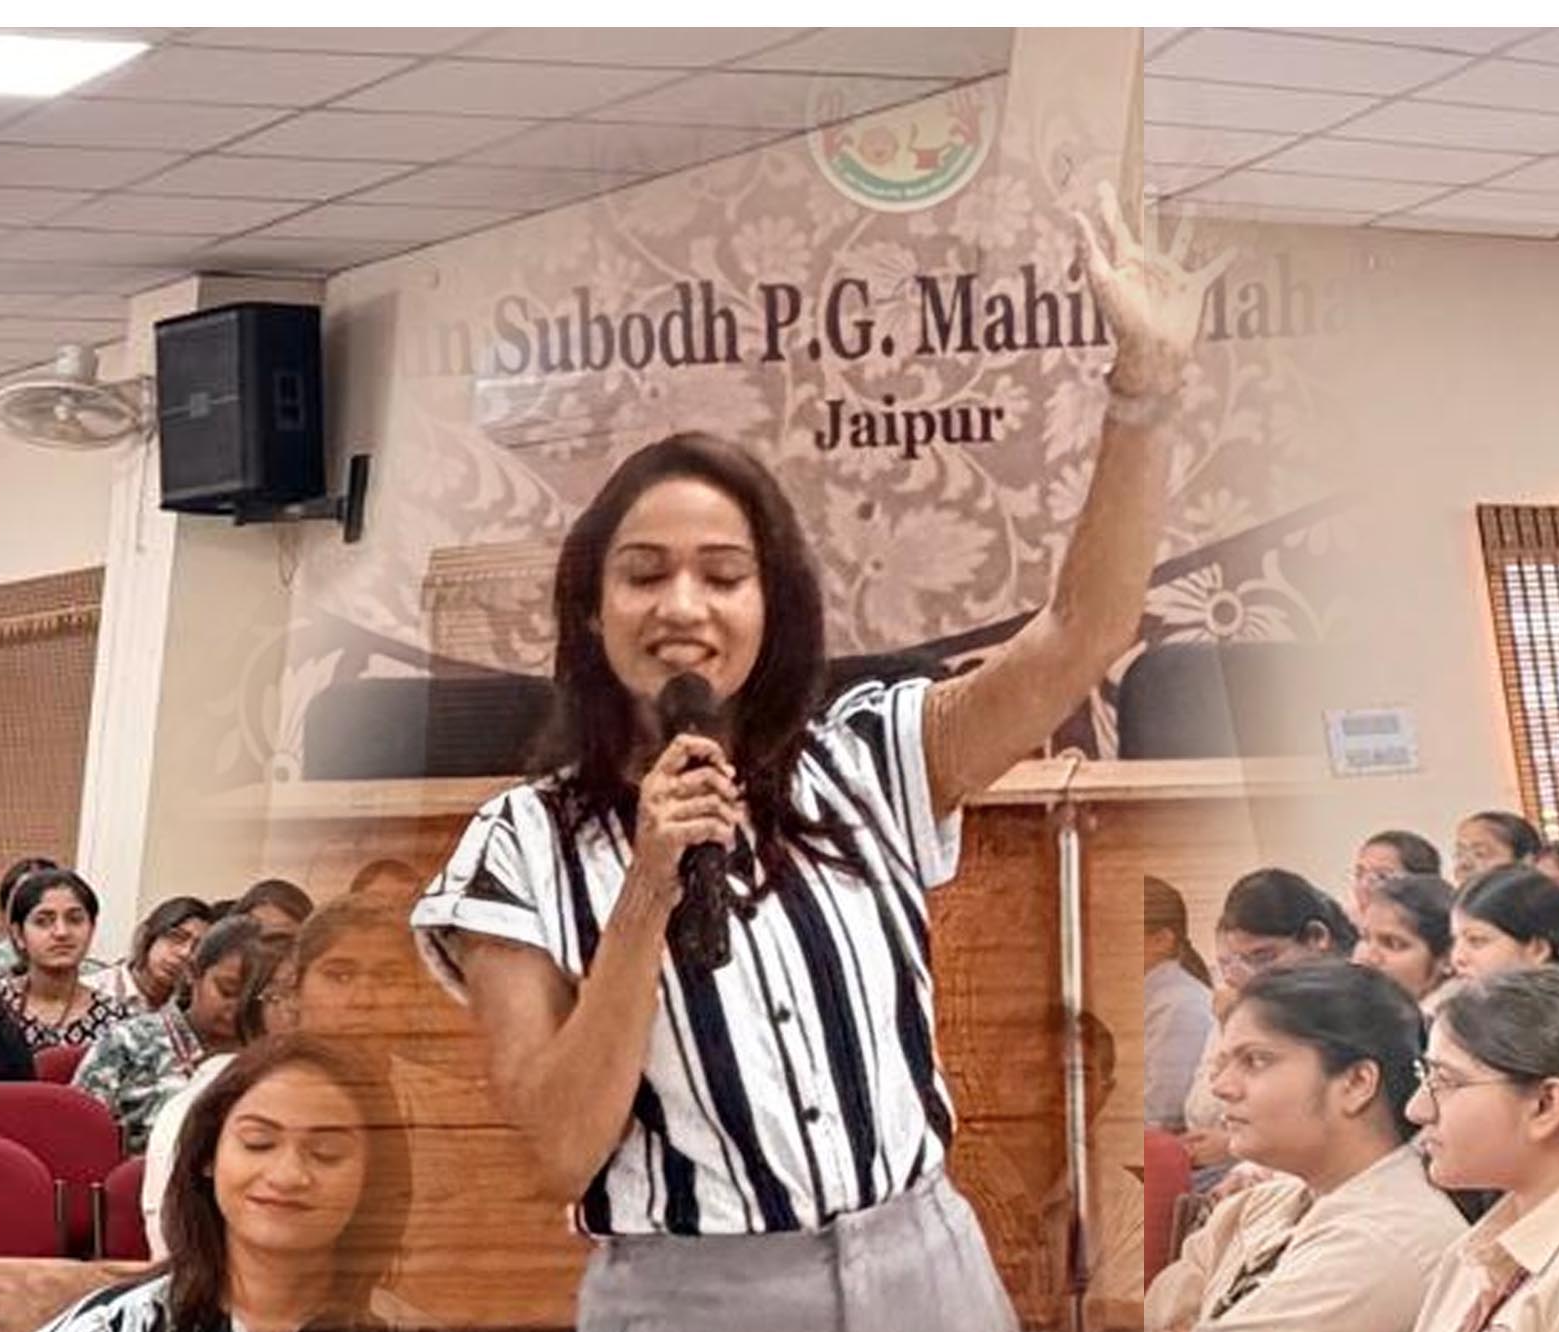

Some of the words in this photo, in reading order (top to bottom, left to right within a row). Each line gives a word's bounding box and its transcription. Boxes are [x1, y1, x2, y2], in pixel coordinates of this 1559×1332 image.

[493, 280, 743, 375] Subodh
[759, 277, 896, 362] P.G.
[915, 263, 1111, 355] Mahil
[815, 394, 1004, 459] Jaipur
